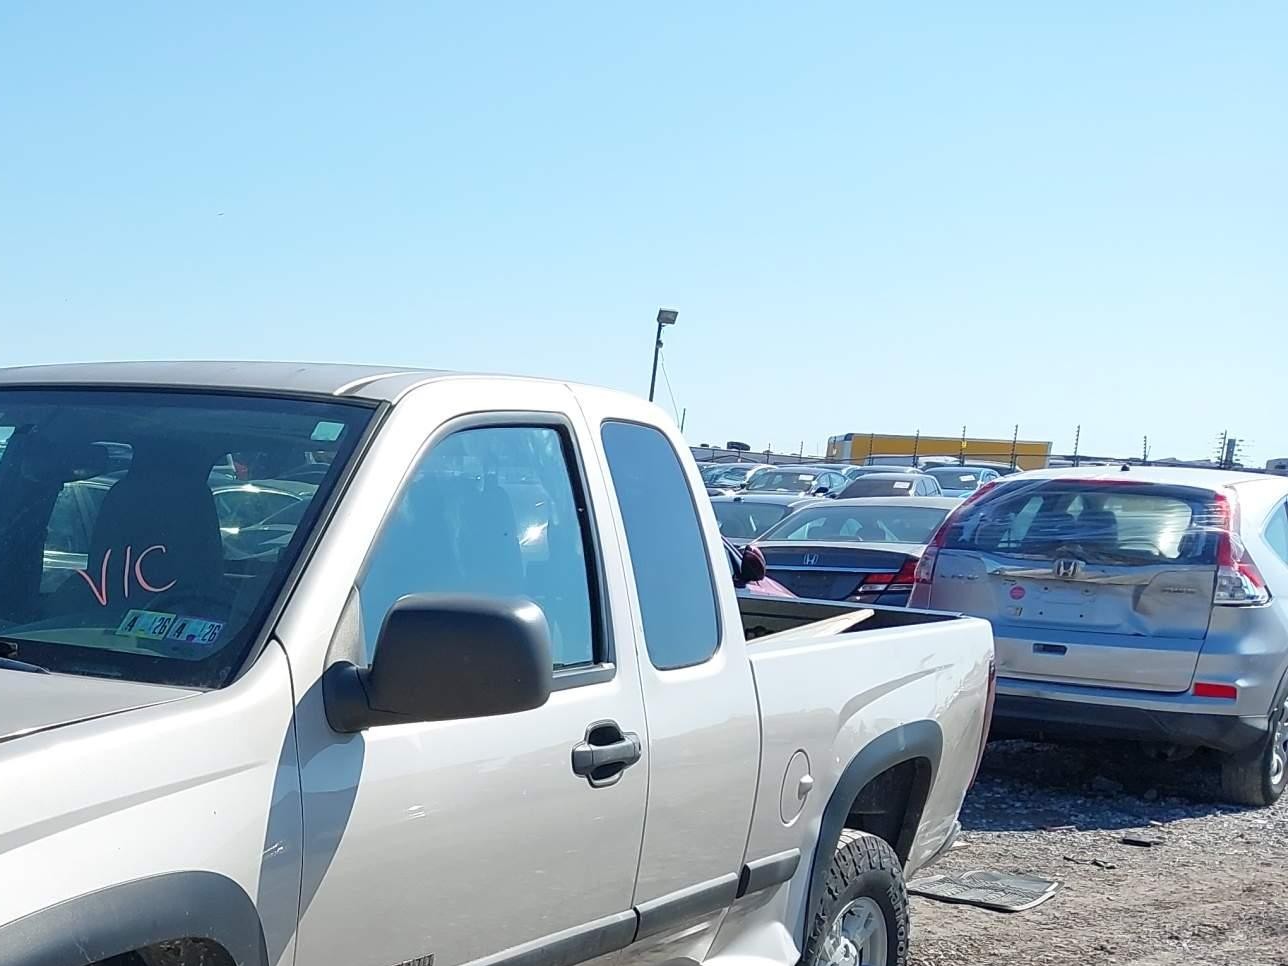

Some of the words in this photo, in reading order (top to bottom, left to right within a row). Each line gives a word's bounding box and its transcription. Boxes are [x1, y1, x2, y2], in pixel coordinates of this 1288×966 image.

[73, 544, 178, 607] VIC
[152, 616, 172, 635] 26
[201, 624, 221, 642] 26
